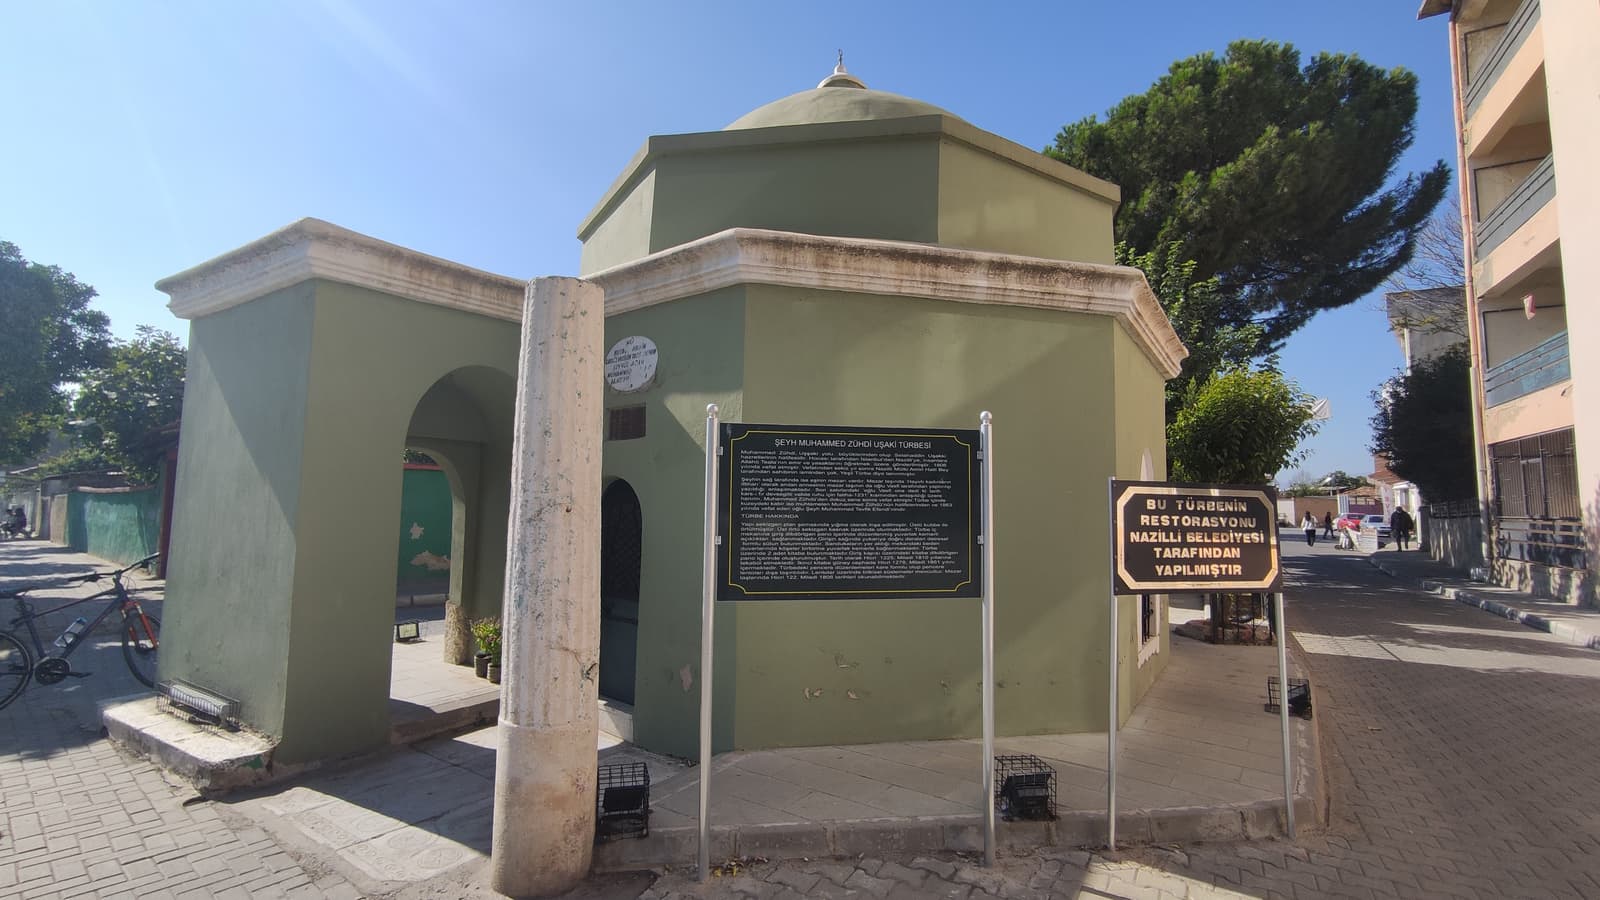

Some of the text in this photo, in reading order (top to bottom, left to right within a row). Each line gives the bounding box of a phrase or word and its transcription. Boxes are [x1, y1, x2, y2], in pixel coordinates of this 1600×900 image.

[873, 440, 896, 448] UŞAKİ
[1147, 497, 1247, 512] BU TÜRBENİN
[1140, 515, 1256, 527] RESTORASYONU
[1130, 529, 1264, 543] NAZİLLİ BELEDİYESİ
[1154, 548, 1240, 558] TARAFINDAN
[1155, 565, 1242, 577] YAPILMIŞTIR
